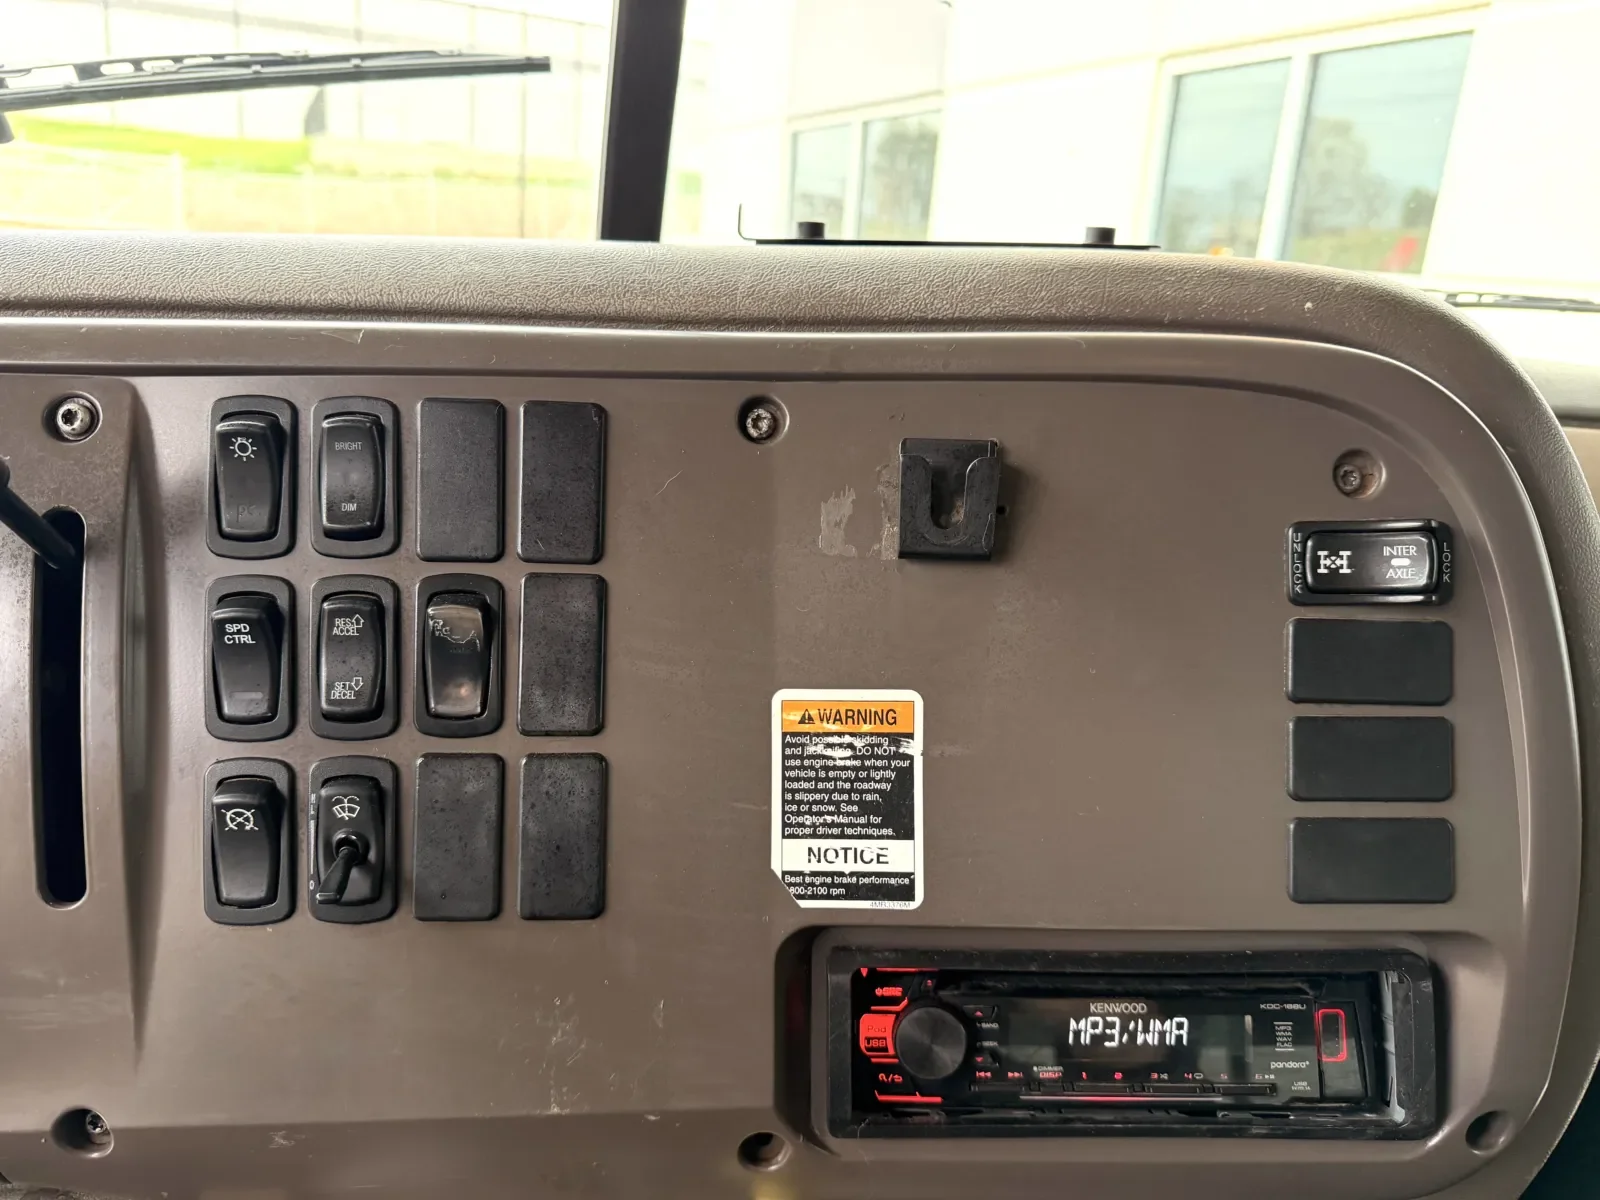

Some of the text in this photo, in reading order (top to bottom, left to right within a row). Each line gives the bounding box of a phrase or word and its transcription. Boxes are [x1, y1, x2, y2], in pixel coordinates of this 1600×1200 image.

[335, 442, 363, 450] BRIGHT
[341, 503, 357, 512] DIM
[1383, 545, 1417, 556] INTER
[1293, 532, 1302, 593] UNLOCK
[1443, 542, 1451, 582] LOCK
[1386, 569, 1416, 578] AXLE
[225, 623, 250, 633] SPD
[332, 626, 360, 636] ACCEL
[224, 634, 256, 645] CTRL
[334, 681, 350, 691] SET
[331, 690, 356, 699] DECEL
[817, 708, 897, 726] WARNING
[785, 735, 810, 744] Avoid
[851, 735, 889, 746] skidding
[785, 746, 801, 755] and
[856, 747, 872, 755] DO
[874, 747, 895, 756] NOT
[804, 758, 833, 768] engine
[837, 758, 862, 767] brake
[864, 758, 888, 767] when
[890, 760, 911, 768] your
[785, 769, 816, 778] vehicle
[819, 769, 826, 778] is
[828, 770, 856, 780] empty
[870, 769, 896, 780] lightly
[785, 781, 892, 791] loaded and the roadway
[785, 792, 882, 802] is slippery due to rain,
[785, 803, 799, 812] ice
[811, 804, 838, 812] snow.
[840, 803, 859, 812] See
[834, 815, 868, 824] Manual
[870, 815, 883, 824] for
[785, 826, 896, 836] proper driver techniques.
[807, 847, 889, 865] NOTICE
[785, 875, 910, 886] Best engine brake performance
[830, 888, 846, 896] rpm
[1090, 1002, 1148, 1014] KENWOOD
[1068, 1016, 1189, 1048] MP3/WMA
[865, 1038, 886, 1047] USB
[1271, 1061, 1306, 1069] pandora
